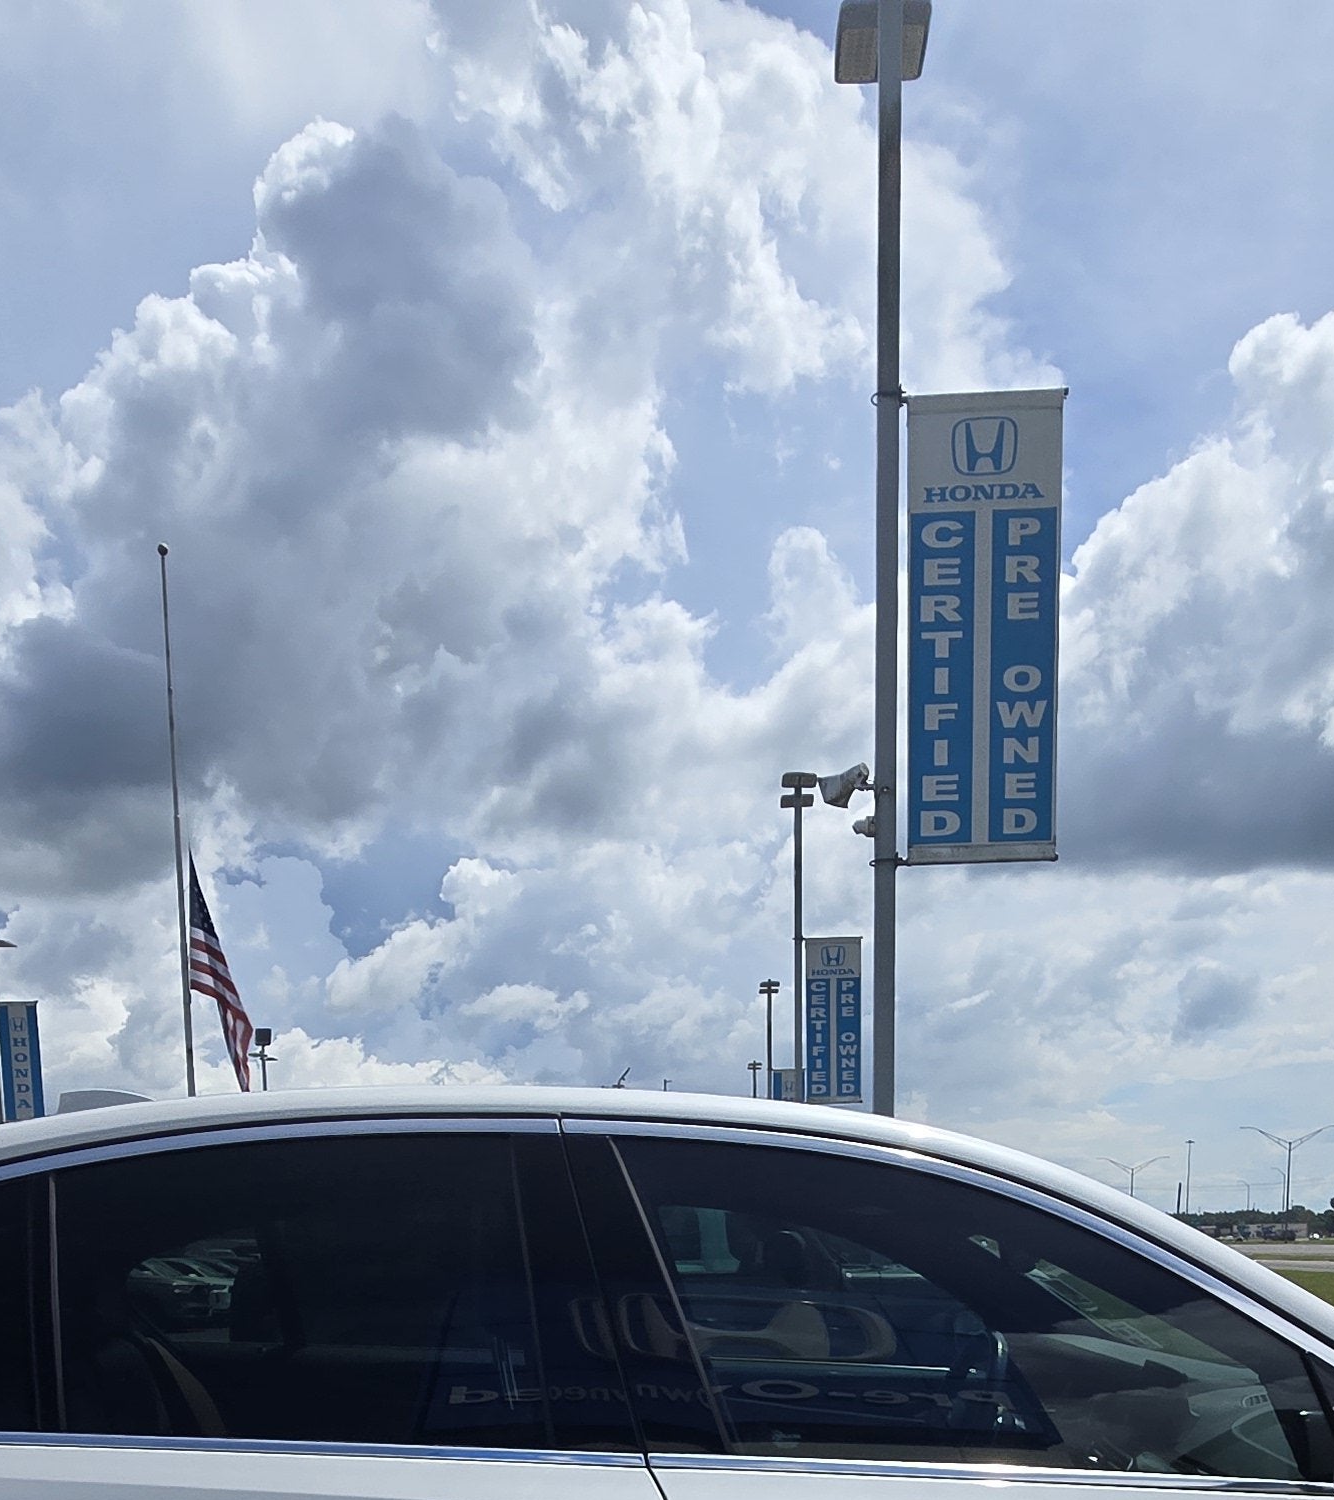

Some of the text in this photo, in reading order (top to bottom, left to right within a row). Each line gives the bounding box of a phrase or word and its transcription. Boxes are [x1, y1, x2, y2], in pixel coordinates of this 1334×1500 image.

[923, 482, 1045, 503] HONDA
[920, 520, 964, 837] CERTIFIED
[996, 517, 1048, 835] PRE OWNED
[811, 968, 855, 976] HONDA
[12, 1037, 32, 1108] HONDA
[810, 981, 827, 1095] CERTIFIED
[839, 980, 858, 1094] PRE OWNED
